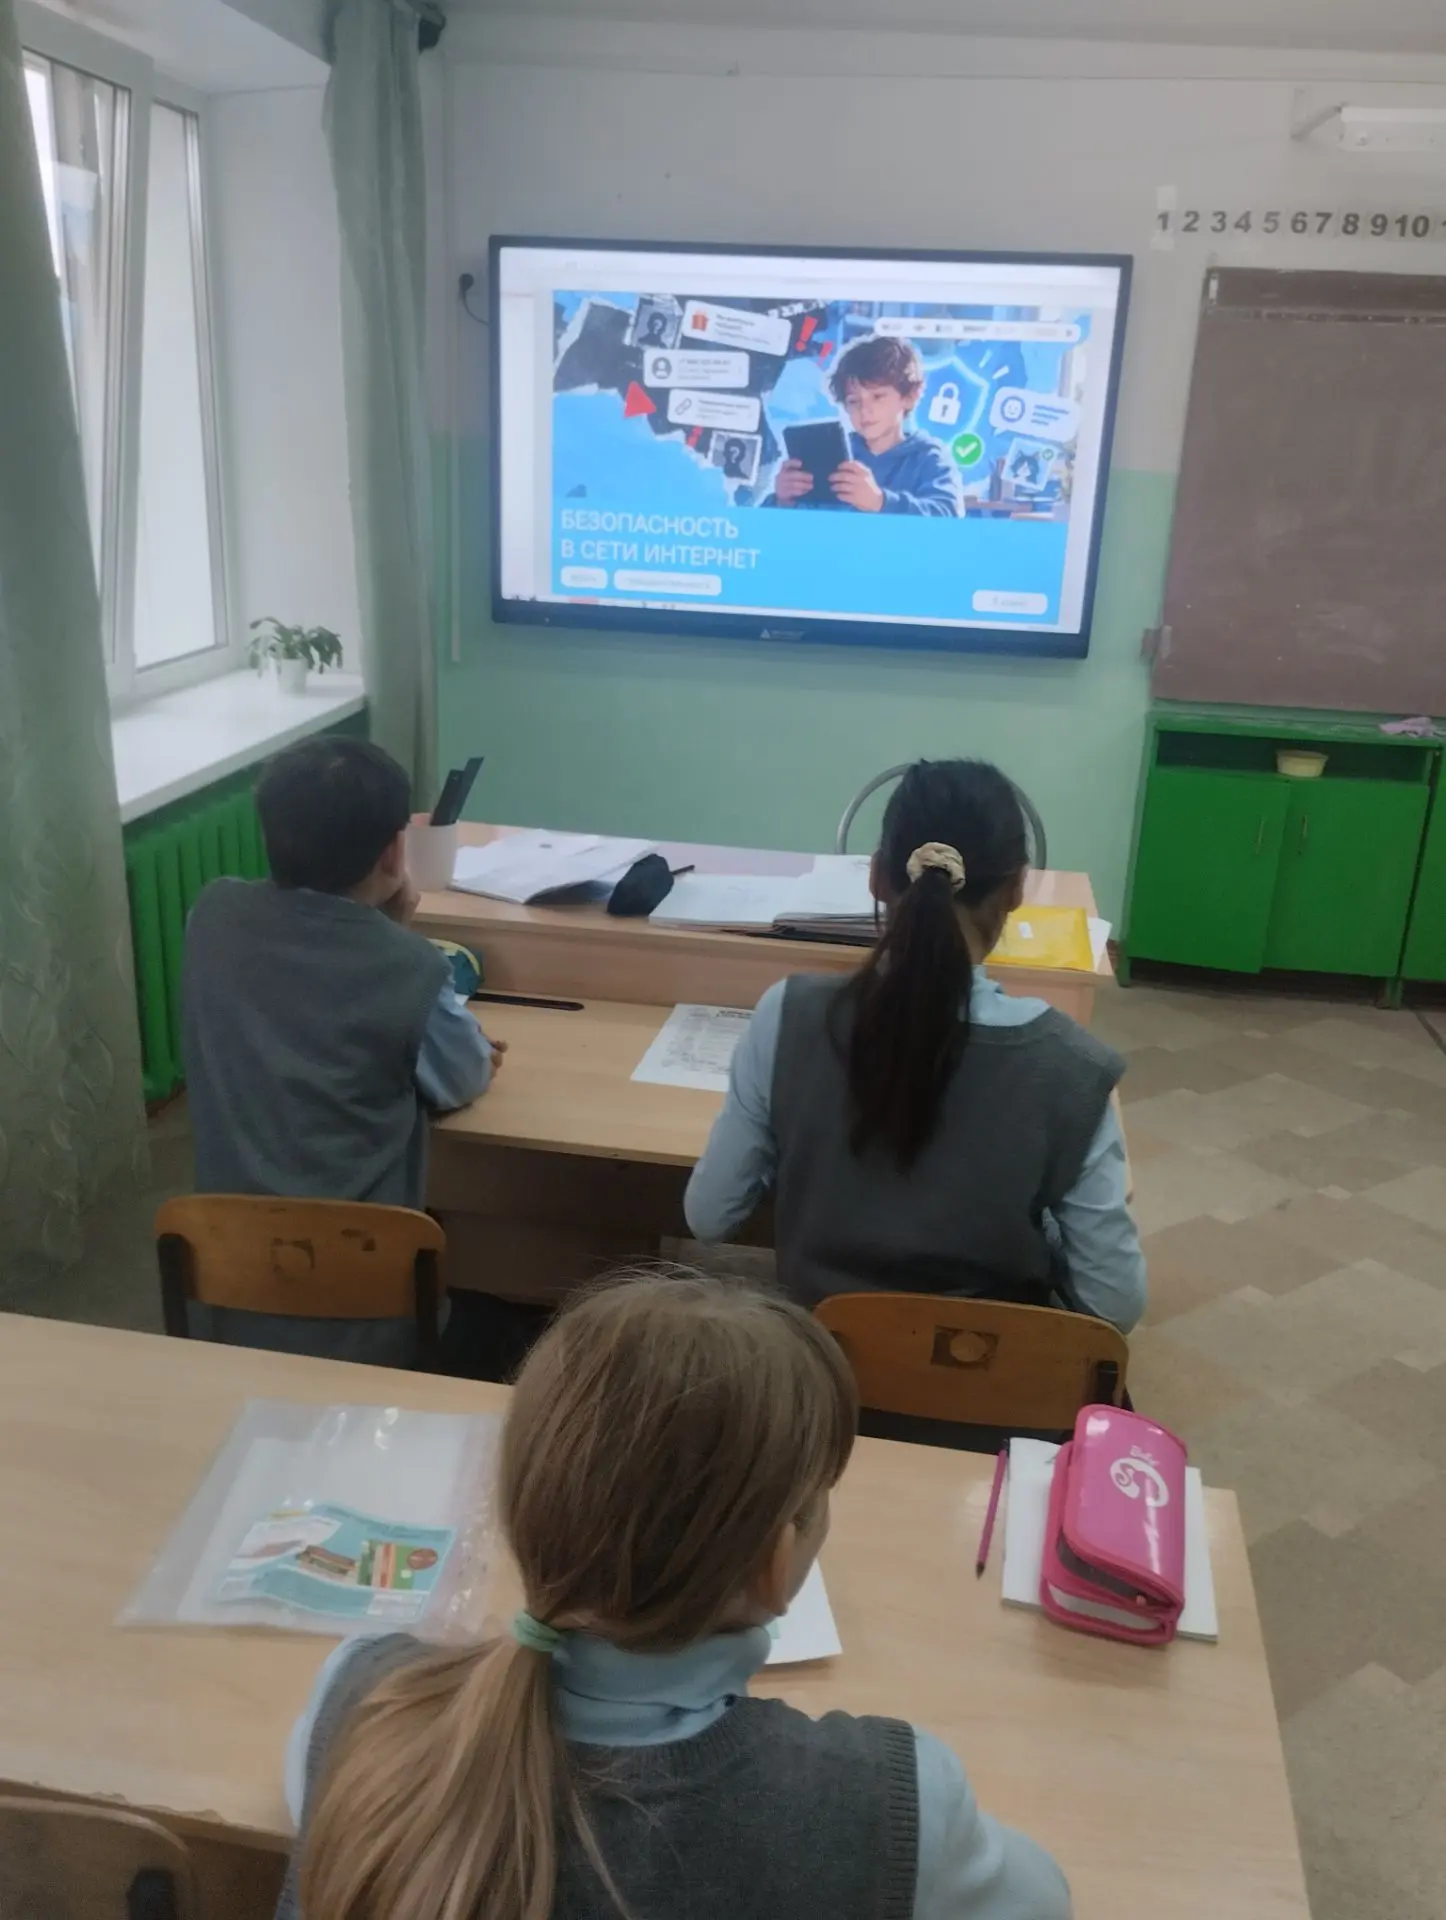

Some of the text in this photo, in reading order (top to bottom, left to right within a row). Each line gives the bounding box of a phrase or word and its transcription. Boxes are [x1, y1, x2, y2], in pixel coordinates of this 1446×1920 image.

[1157, 210, 1431, 239] 1 2 3 4 5 6 7 8 9 10
[561, 508, 740, 540] БЕЗОПАСНОСТЬ
[561, 538, 762, 570] В СЕТИ ИНТЕРНЕТ
